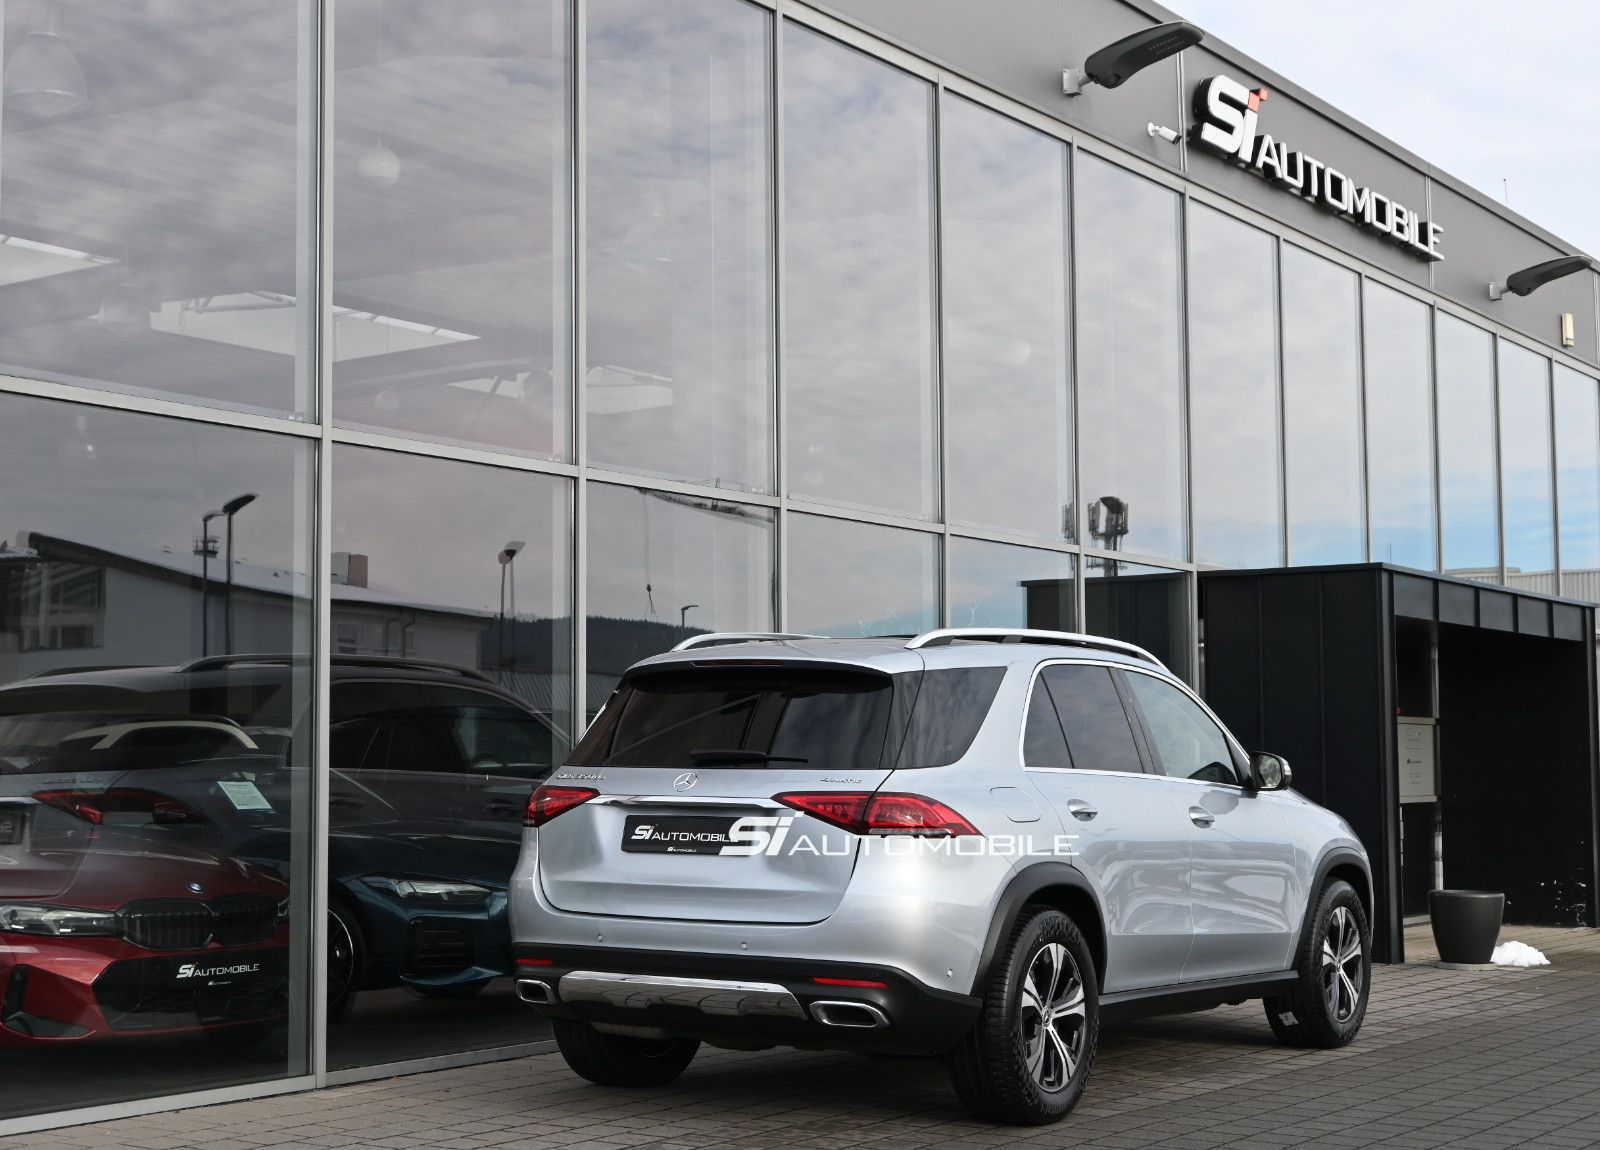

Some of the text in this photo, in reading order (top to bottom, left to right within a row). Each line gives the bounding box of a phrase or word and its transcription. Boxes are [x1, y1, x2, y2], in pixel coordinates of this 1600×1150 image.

[1254, 133, 1445, 262] AUTOMOBILE
[651, 831, 738, 843] AUTOMOBIL
[193, 963, 260, 977] AUTOMOBILE
